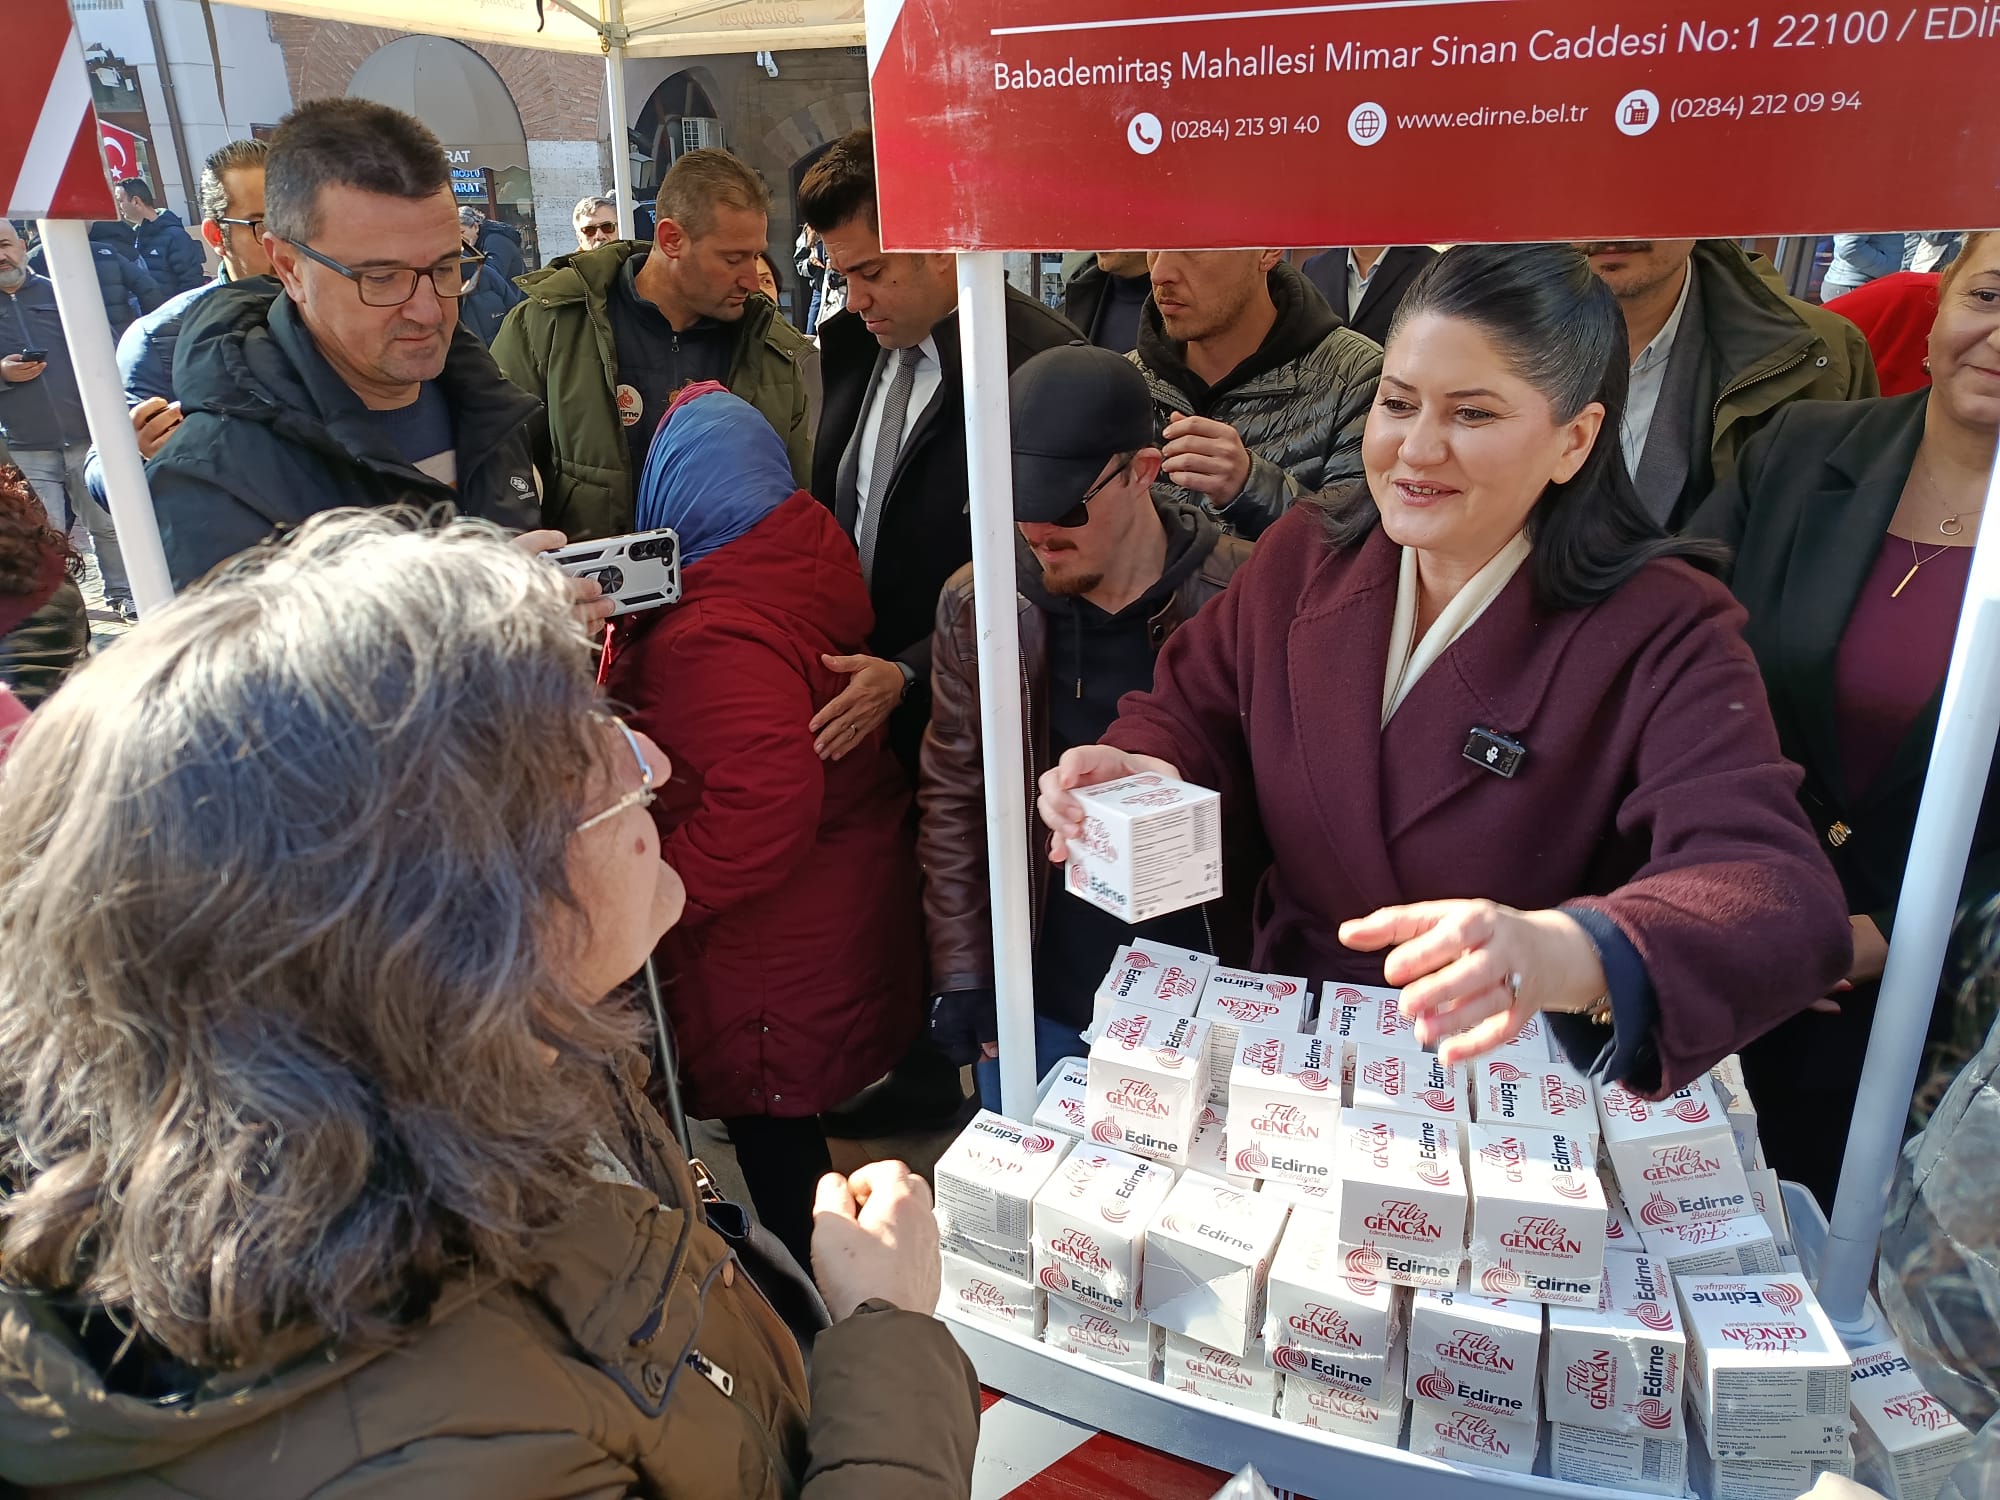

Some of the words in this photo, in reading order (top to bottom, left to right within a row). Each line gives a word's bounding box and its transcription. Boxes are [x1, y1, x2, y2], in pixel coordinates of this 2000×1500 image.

[994, 57, 1173, 91] Babademirtaş
[1182, 44, 1314, 80] Mahallesi
[1327, 41, 1422, 72] Mimar
[1431, 35, 1517, 67] Sinan
[1528, 25, 1666, 60] Caddesi
[1677, 18, 1759, 54] No:1
[1773, 11, 1888, 48] 22100
[1896, 8, 1917, 42] /
[1397, 103, 1589, 131] www.edirne.bel.tr
[1670, 95, 1744, 122] (0284)
[1751, 94, 1786, 115] 212
[1793, 92, 1825, 113] 09
[1830, 90, 1862, 112] 94
[1171, 118, 1229, 143] (0284)
[1235, 117, 1264, 137] 213
[1269, 116, 1288, 136] 91
[1294, 114, 1320, 135] 40
[444, 150, 470, 163] RAT
[1118, 968, 1142, 997] Edirne
[1214, 976, 1264, 991] Edirne
[1217, 998, 1280, 1015] GENCAN
[1382, 999, 1399, 1036] GENCAN
[1122, 1014, 1148, 1051] GENCAN
[1165, 1018, 1189, 1048] Edirne
[1339, 1005, 1357, 1037] Edirne
[1261, 1038, 1280, 1076] GENCAN
[1305, 1038, 1322, 1069] Edirne
[1384, 1056, 1399, 1096] GENCAN
[1106, 1091, 1169, 1116] GENCAN
[1120, 1078, 1158, 1106] Filiz
[1501, 1083, 1518, 1118] Edirne
[1545, 1074, 1566, 1116] GENCAN
[1250, 1118, 1319, 1138] GENCAN
[1265, 1103, 1306, 1129] Filiz
[974, 1122, 1023, 1144] Edirne
[1125, 1129, 1178, 1152] Edirne
[1419, 1122, 1436, 1160] Edirne
[1272, 1156, 1328, 1176] Edirne
[1551, 1134, 1571, 1173] Edirne
[1652, 1145, 1700, 1168] Filiz
[1115, 1162, 1149, 1199] Edirne
[1643, 1157, 1721, 1180] GENCAN
[1381, 1200, 1428, 1229] Filiz
[1679, 1194, 1745, 1213] Edirne
[1690, 1206, 1741, 1220] Belediyesi
[1197, 1223, 1254, 1252] Edirne
[1364, 1216, 1442, 1238] GENCAN
[1517, 1216, 1567, 1244] Filiz
[1051, 1239, 1112, 1271] GENCAN
[1063, 1227, 1100, 1258] Filiz
[1500, 1233, 1582, 1254] GENCAN
[1387, 1256, 1450, 1278] Edirne
[1392, 1270, 1442, 1286] Belediyesi
[1636, 1257, 1657, 1301] Edirne
[971, 1278, 1005, 1306] Filiz
[1071, 1278, 1124, 1308] Edirne
[1524, 1274, 1591, 1294] Edirne
[1530, 1288, 1583, 1304] Belediyesi
[1692, 1291, 1762, 1305] Edirne
[1080, 1313, 1118, 1341] Filiz
[1289, 1315, 1362, 1347] GENCAN
[1304, 1302, 1349, 1334] Filiz
[1067, 1325, 1130, 1353] GENCAN
[1453, 1329, 1500, 1360] Filiz
[1721, 1326, 1807, 1341] GENCAN
[1200, 1346, 1240, 1374] Filiz
[1435, 1343, 1514, 1371] GENCAN
[1186, 1359, 1253, 1386] GENCAN
[1311, 1358, 1372, 1386] Edirne
[1316, 1372, 1365, 1393] Belediyesi
[1566, 1359, 1597, 1394] Filiz
[1591, 1349, 1610, 1410] GENCAN
[1642, 1345, 1665, 1398] Edirne
[1663, 1353, 1678, 1394] Belediyesi
[1308, 1394, 1379, 1420] GENCAN
[1458, 1384, 1523, 1410] Edirne
[1463, 1399, 1516, 1417] Belediyesi
[1435, 1423, 1510, 1455] GENCAN
[1452, 1411, 1496, 1442] Filiz
